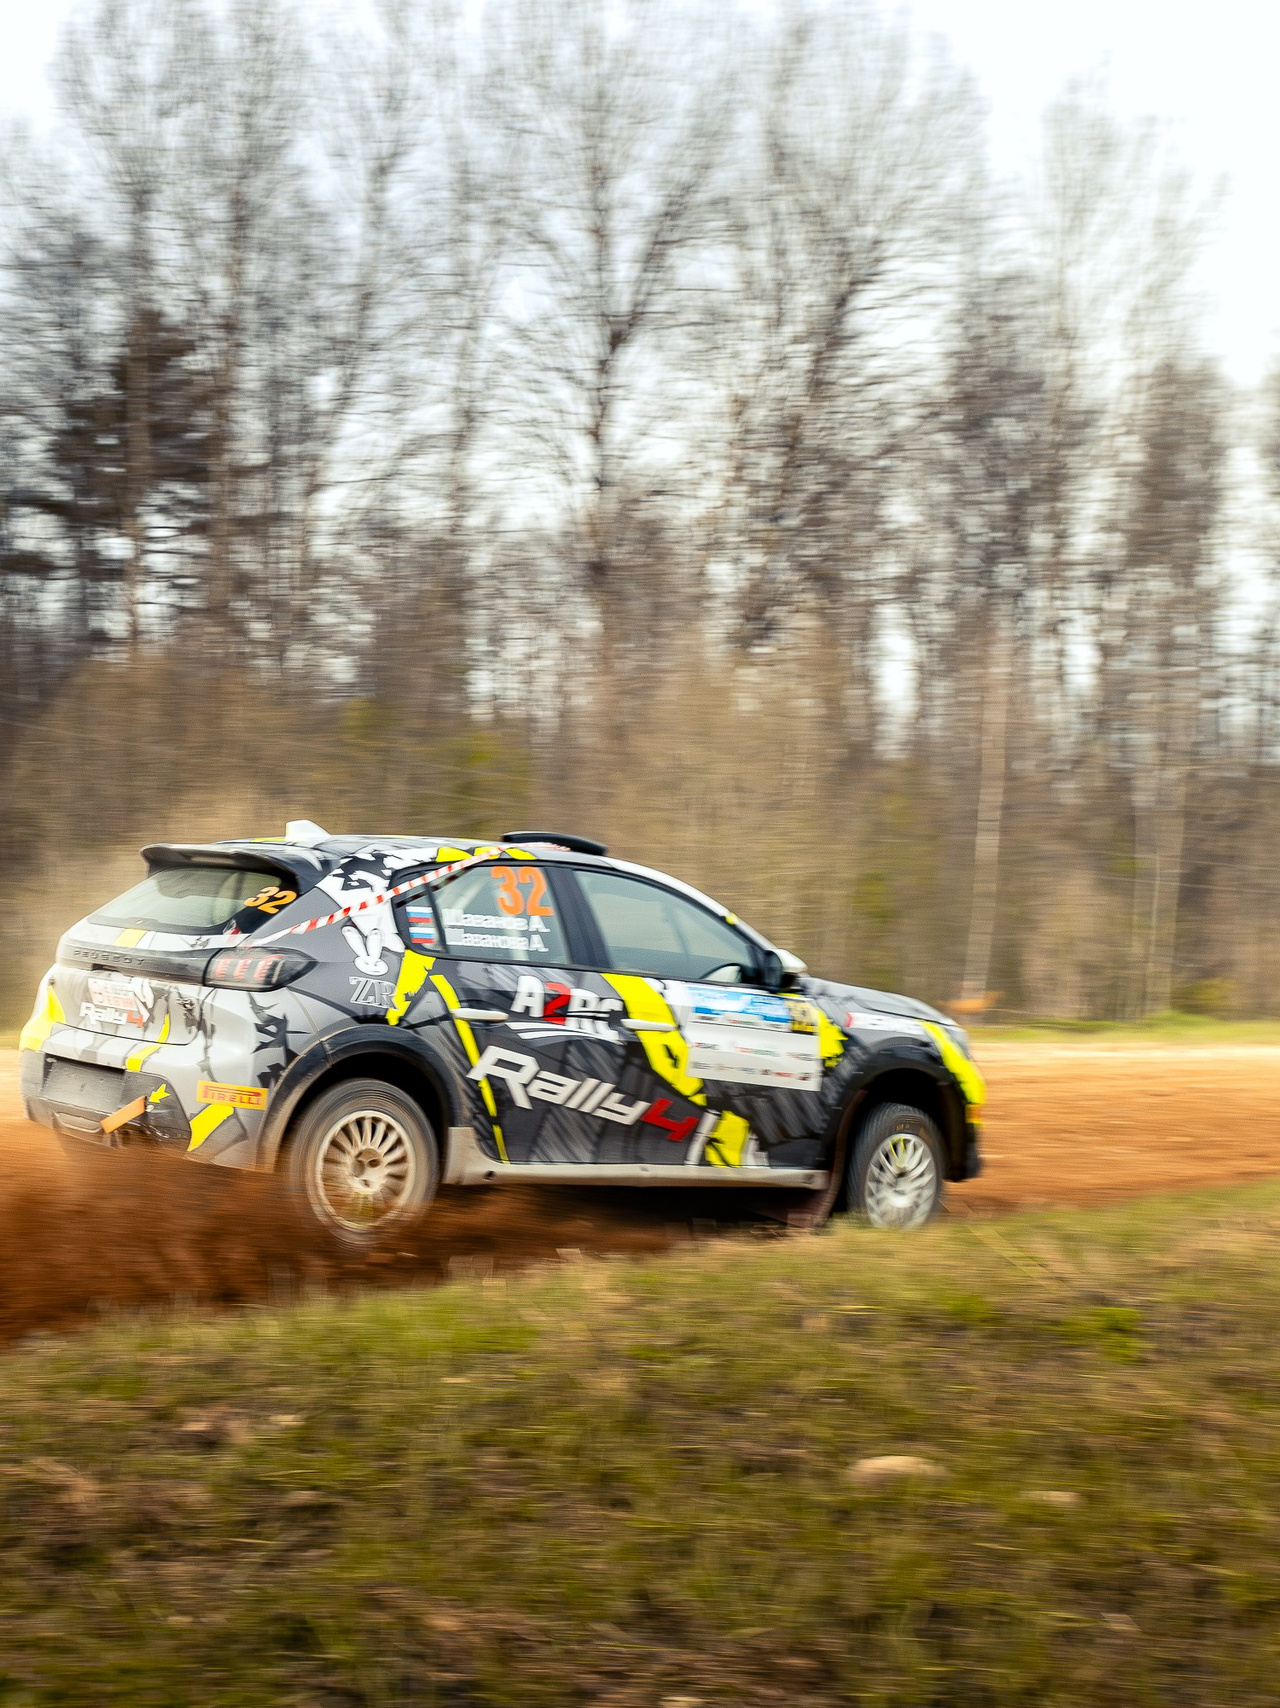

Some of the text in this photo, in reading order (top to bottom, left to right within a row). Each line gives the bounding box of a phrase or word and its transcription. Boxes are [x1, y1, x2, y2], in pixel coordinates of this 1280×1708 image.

[243, 886, 297, 914] 32
[491, 866, 554, 916] 32
[80, 1001, 144, 1028] Rally4
[203, 1085, 262, 1105] PIRELLI
[466, 1045, 699, 1142] Rally4
